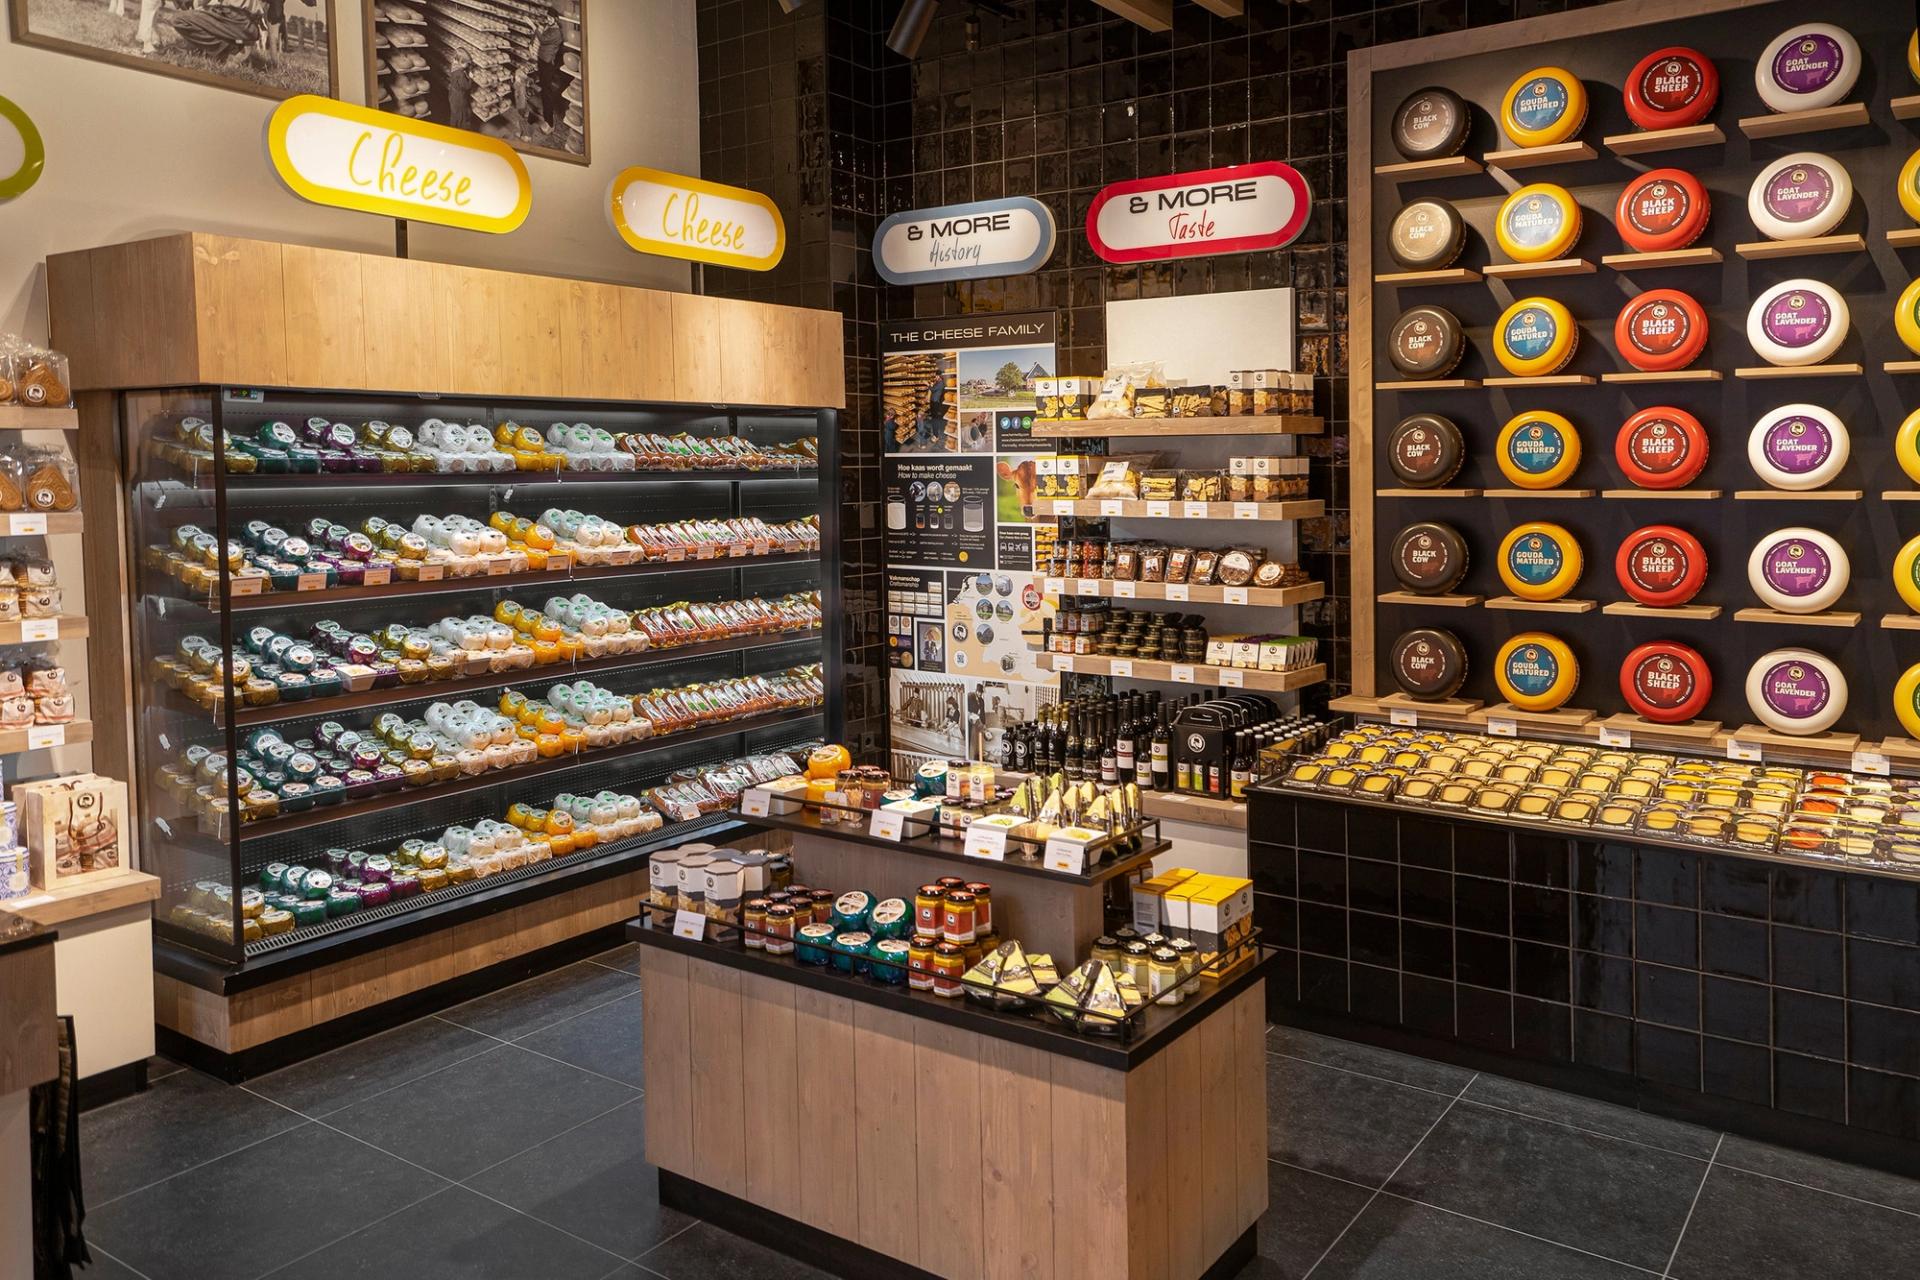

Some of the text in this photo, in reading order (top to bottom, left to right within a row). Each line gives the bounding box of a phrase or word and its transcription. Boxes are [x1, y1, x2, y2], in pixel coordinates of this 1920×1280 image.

[1786, 58, 1808, 66] GOAT
[1786, 60, 1828, 72] LAVENDER
[1655, 75, 1689, 85] BLACK
[1654, 82, 1688, 93] SHEEP
[1520, 98, 1548, 107] GOUDA
[1520, 100, 1558, 112] MATURED
[1413, 114, 1437, 124] BLACK
[1413, 121, 1430, 130] COW
[348, 130, 472, 207] Cheese
[1777, 190, 1819, 201] LAVENDER
[1778, 187, 1799, 195] GOAT
[1130, 181, 1257, 214] & MORE
[1642, 198, 1675, 208] BLACK
[1642, 205, 1674, 216] SHEEP
[661, 193, 745, 246] Cheese
[1516, 213, 1542, 222] GOUDA
[907, 213, 1010, 241] & MORE
[1168, 210, 1215, 240] Taste
[1516, 218, 1553, 228] MATURED
[1410, 225, 1434, 233] BLACK
[1409, 231, 1426, 239] COW
[929, 237, 982, 268] History
[1643, 319, 1675, 327] BLACK
[890, 323, 1045, 343] THE CHEESE FAMILY
[1511, 327, 1537, 336] GOUDA
[1642, 326, 1674, 335] SHEEP
[1409, 335, 1432, 344] BLACK
[1511, 331, 1548, 341] MATURED
[1409, 341, 1424, 349] COW
[1643, 438, 1674, 446] BLACK
[1407, 444, 1430, 452] BLACK
[1516, 446, 1554, 454] MATURED
[1642, 445, 1675, 454] SHEEP
[1407, 449, 1423, 458] COW
[898, 464, 973, 473] Hoe kaas wordt gemaakt
[1413, 550, 1436, 558] BLACK
[1516, 557, 1554, 565] MATURED
[1643, 557, 1674, 565] BLACK
[1642, 564, 1675, 572] SHEEP
[1412, 657, 1434, 665] BLACK
[1513, 662, 1539, 670] GOUDA
[1513, 668, 1549, 676] MATURED
[1648, 672, 1680, 681] BLACK
[1647, 679, 1679, 689] SHEEP
[1775, 688, 1816, 697] LAVENDER
